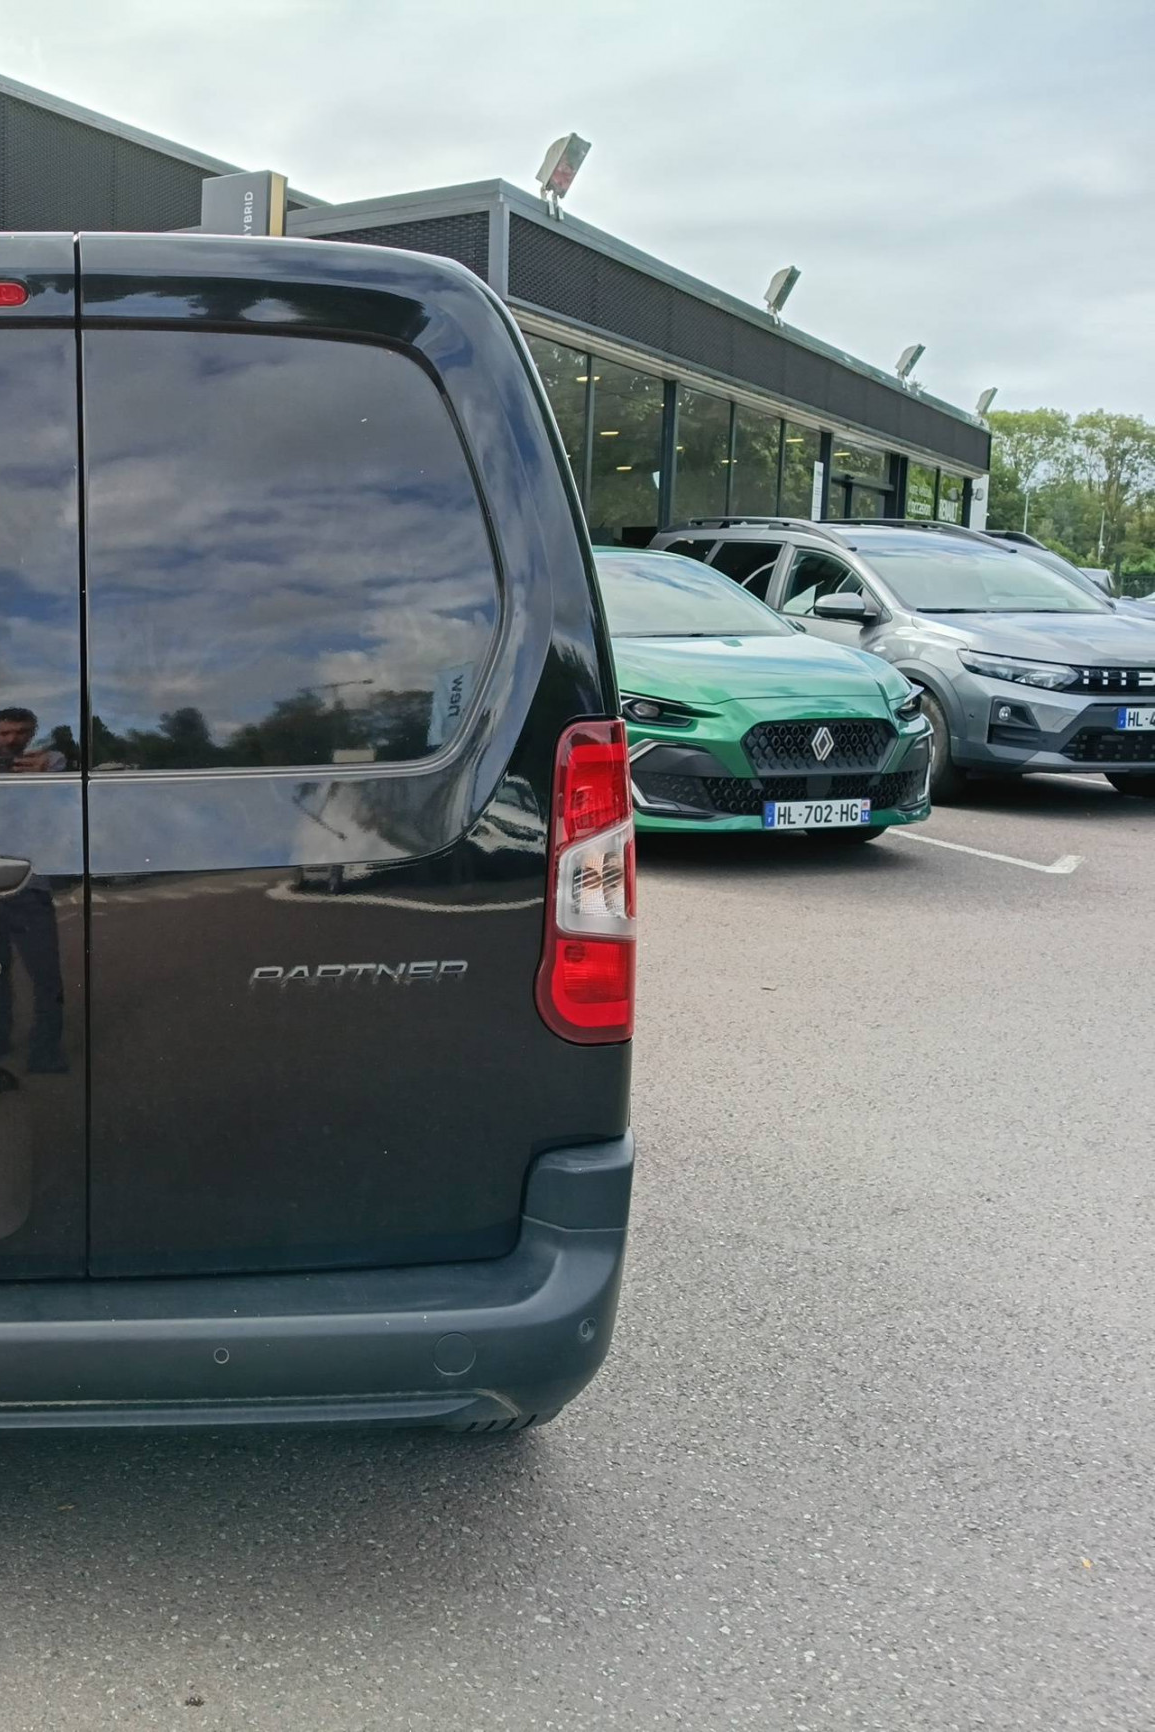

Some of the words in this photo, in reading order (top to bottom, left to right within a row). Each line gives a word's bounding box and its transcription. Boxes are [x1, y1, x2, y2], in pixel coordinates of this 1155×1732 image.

[243, 191, 254, 236] YBRID
[777, 803, 859, 825] HL-702-HG
[249, 960, 468, 986] PARTNER
